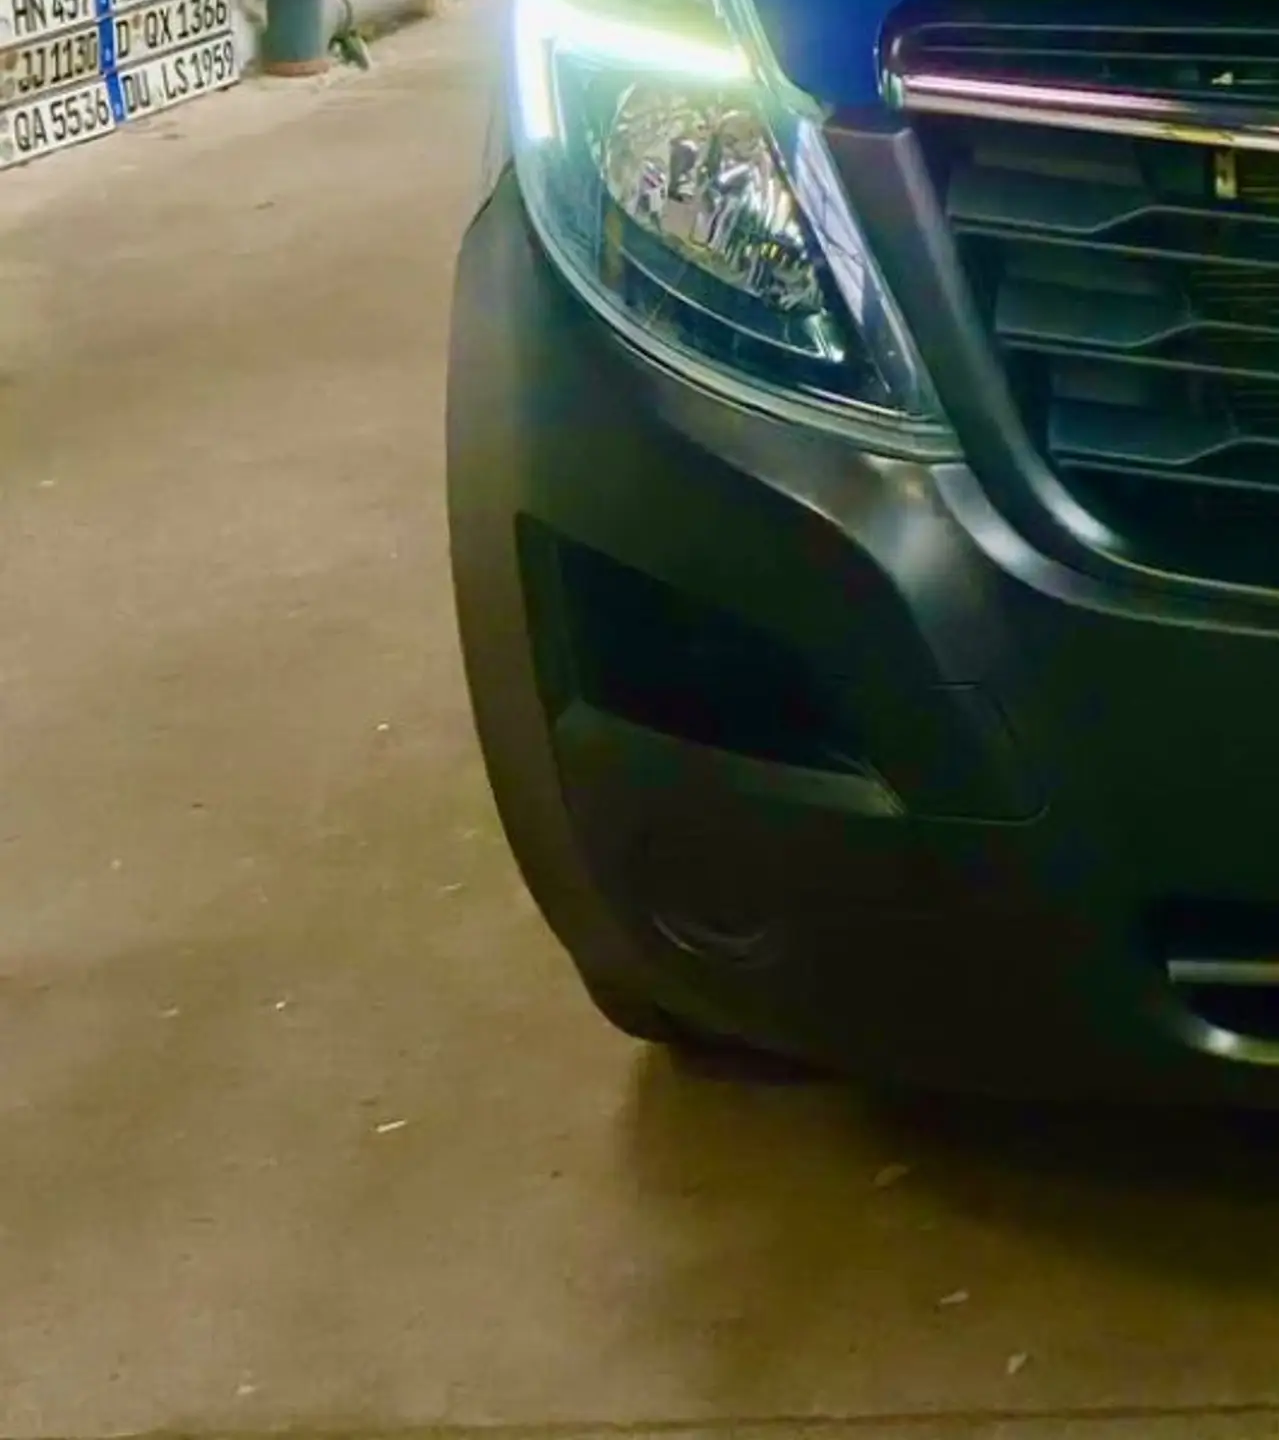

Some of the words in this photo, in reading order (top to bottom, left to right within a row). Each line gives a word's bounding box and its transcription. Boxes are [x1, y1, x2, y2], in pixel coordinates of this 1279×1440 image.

[120, 69, 150, 114] DU
[161, 56, 187, 100] LS
[192, 40, 234, 90] 1959
[13, 107, 48, 153] QA
[50, 89, 110, 141] 5536
